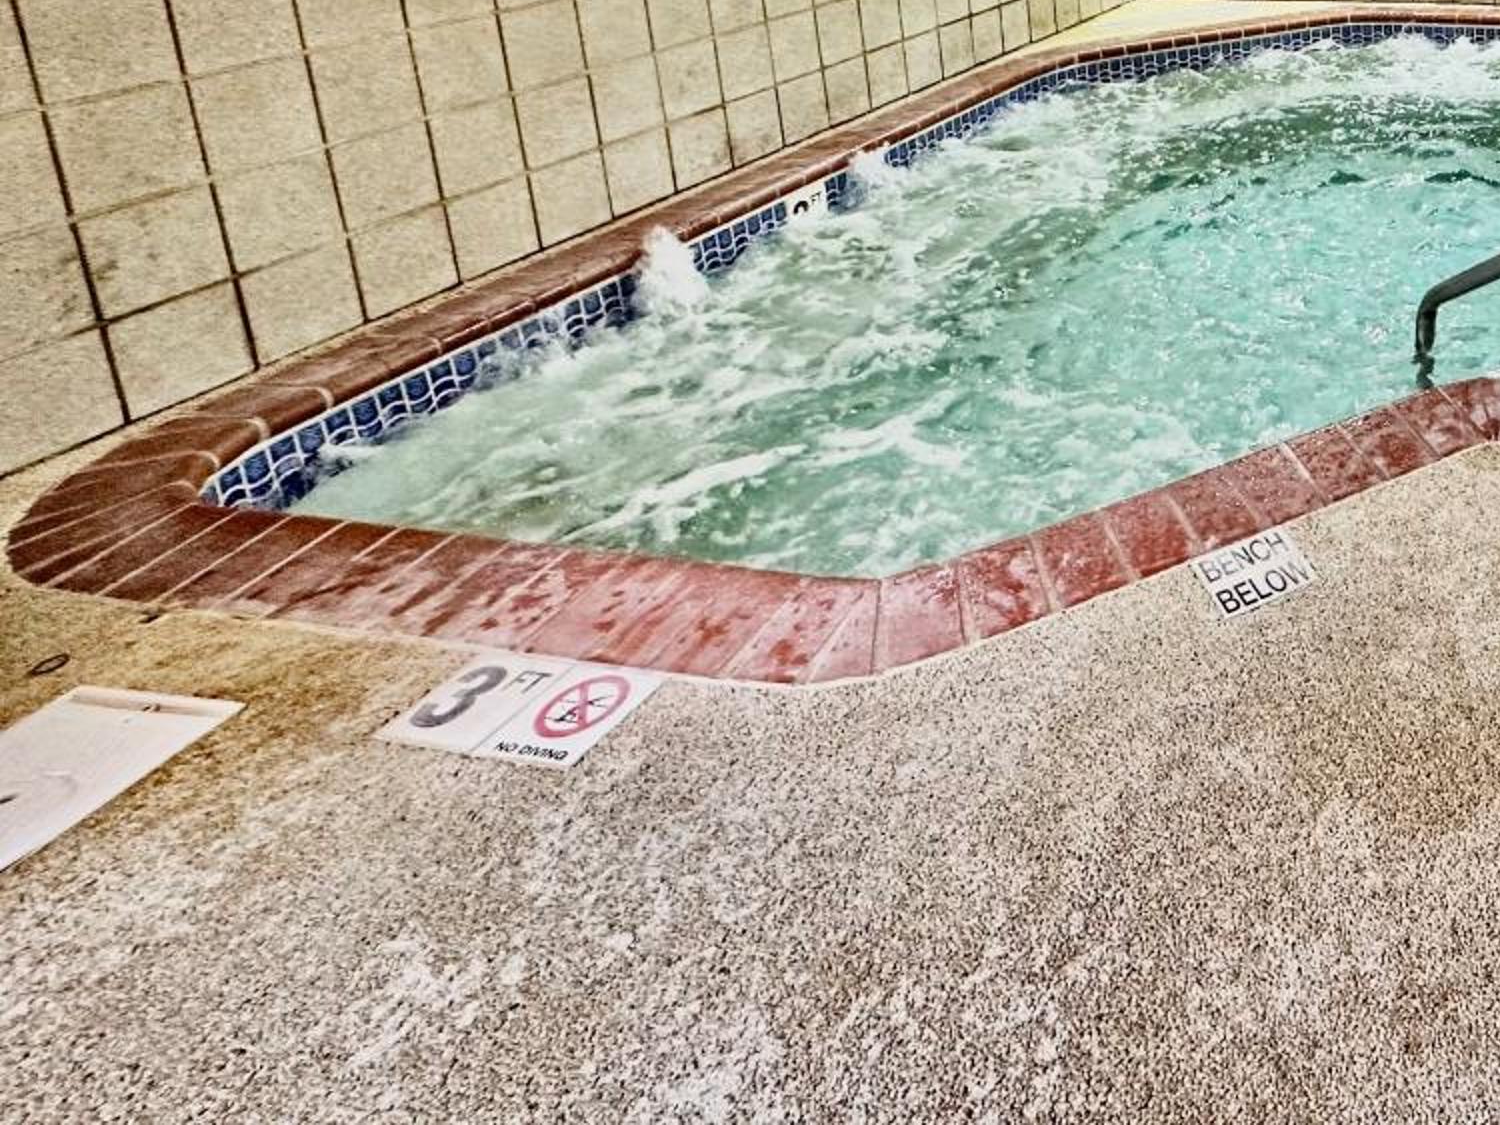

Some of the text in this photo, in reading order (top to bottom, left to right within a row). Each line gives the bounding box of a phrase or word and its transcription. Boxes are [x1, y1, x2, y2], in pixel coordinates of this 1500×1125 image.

[1199, 532, 1289, 583] BENCH
[1216, 561, 1310, 614] BELOW
[410, 665, 554, 728] 3 FT
